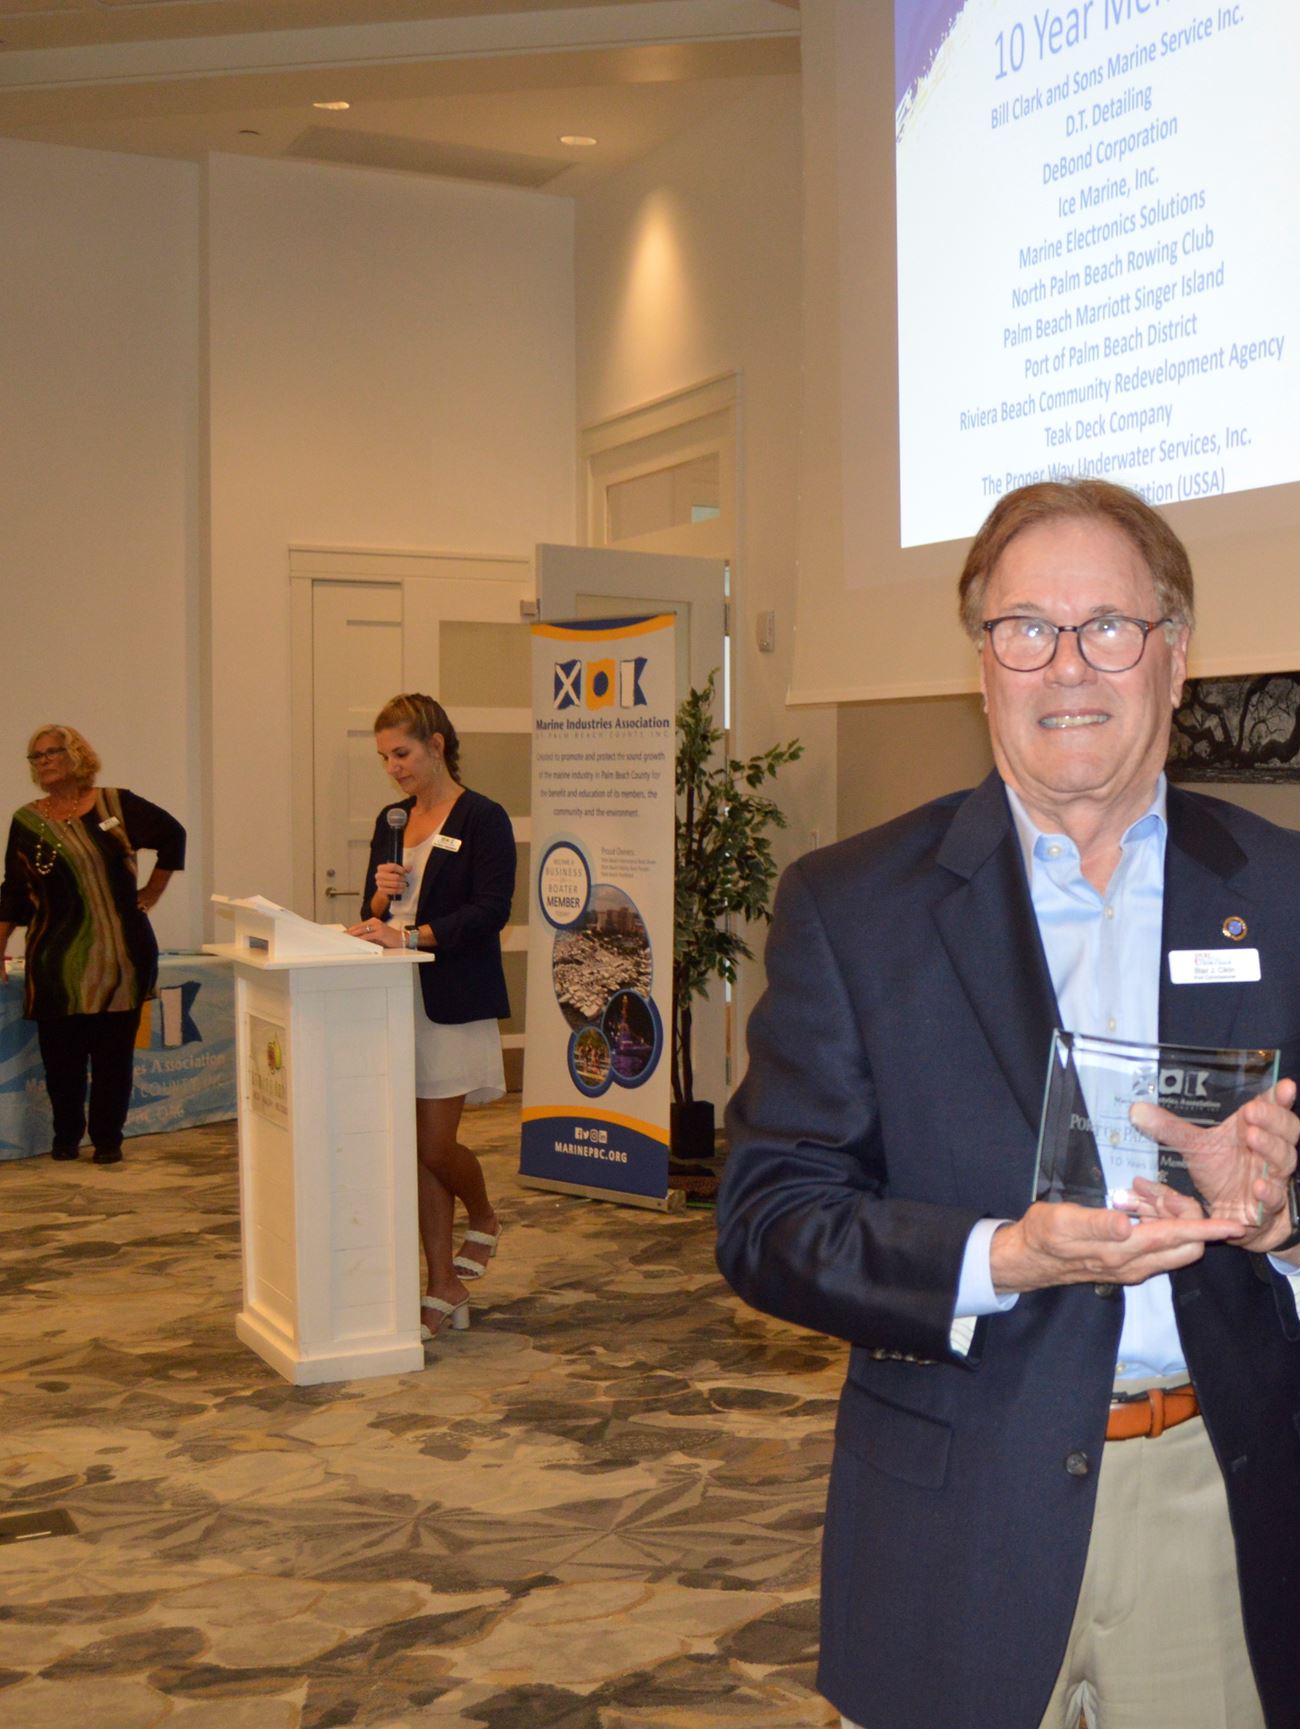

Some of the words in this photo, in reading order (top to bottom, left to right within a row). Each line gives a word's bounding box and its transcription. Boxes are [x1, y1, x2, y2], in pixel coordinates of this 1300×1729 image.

[991, 100, 1009, 129] Bill
[1012, 88, 1043, 120] Clark
[1046, 74, 1069, 107] and
[1072, 64, 1103, 95] Sons
[1107, 41, 1156, 80] Marine
[1160, 16, 1213, 57] Service
[1217, 5, 1244, 32] Inc.
[994, 21, 1025, 81] 10
[1034, 1, 1093, 60] Year
[1065, 109, 1088, 137] D.T.
[1092, 85, 1152, 126] Detailing
[1042, 143, 1092, 185] DeBond
[1096, 116, 1178, 164] Corporation
[1058, 196, 1076, 218] Ice
[1080, 177, 1131, 211] Marine,
[1135, 166, 1159, 190] Inc.
[1019, 239, 1062, 269] Marine
[1066, 213, 1136, 254] Electronics
[1140, 189, 1206, 229] Solutions
[1011, 278, 1047, 309] North
[1049, 270, 1080, 297] Palm
[1084, 254, 1123, 287] Beach
[1127, 240, 1178, 273] Rowing
[1182, 224, 1214, 256] Club
[1003, 322, 1032, 349] Palm
[1036, 308, 1072, 339] Beach
[1076, 293, 1131, 328] Marriott
[1134, 281, 1178, 311] Singer
[1181, 260, 1225, 298] Island
[1024, 355, 1050, 380] Port
[1053, 348, 1067, 372] of
[1069, 342, 1100, 369] Palm
[1103, 327, 1143, 358] Beach
[1147, 313, 1198, 346] District
[960, 404, 998, 431] Riviera
[1001, 394, 1036, 422] Beach
[1039, 378, 1112, 413] Community
[1114, 347, 1225, 394] Redevelopment
[1228, 335, 1285, 370] Agency
[1044, 423, 1072, 448] Teak
[1075, 413, 1106, 442] Deck
[1109, 402, 1173, 434] Company
[982, 476, 1002, 497] The
[1078, 443, 1155, 478] Underwater
[1159, 430, 1221, 462] Services,
[1226, 426, 1251, 449] Inc.
[1177, 467, 1225, 501] (USSA)
[536, 718, 564, 730] Marine
[566, 717, 612, 730] Industries
[615, 716, 670, 729] Association
[546, 867, 582, 877] BUSINESS
[547, 896, 581, 909] MEMBER
[554, 1141, 628, 1163] MARINEPBC.ORG
